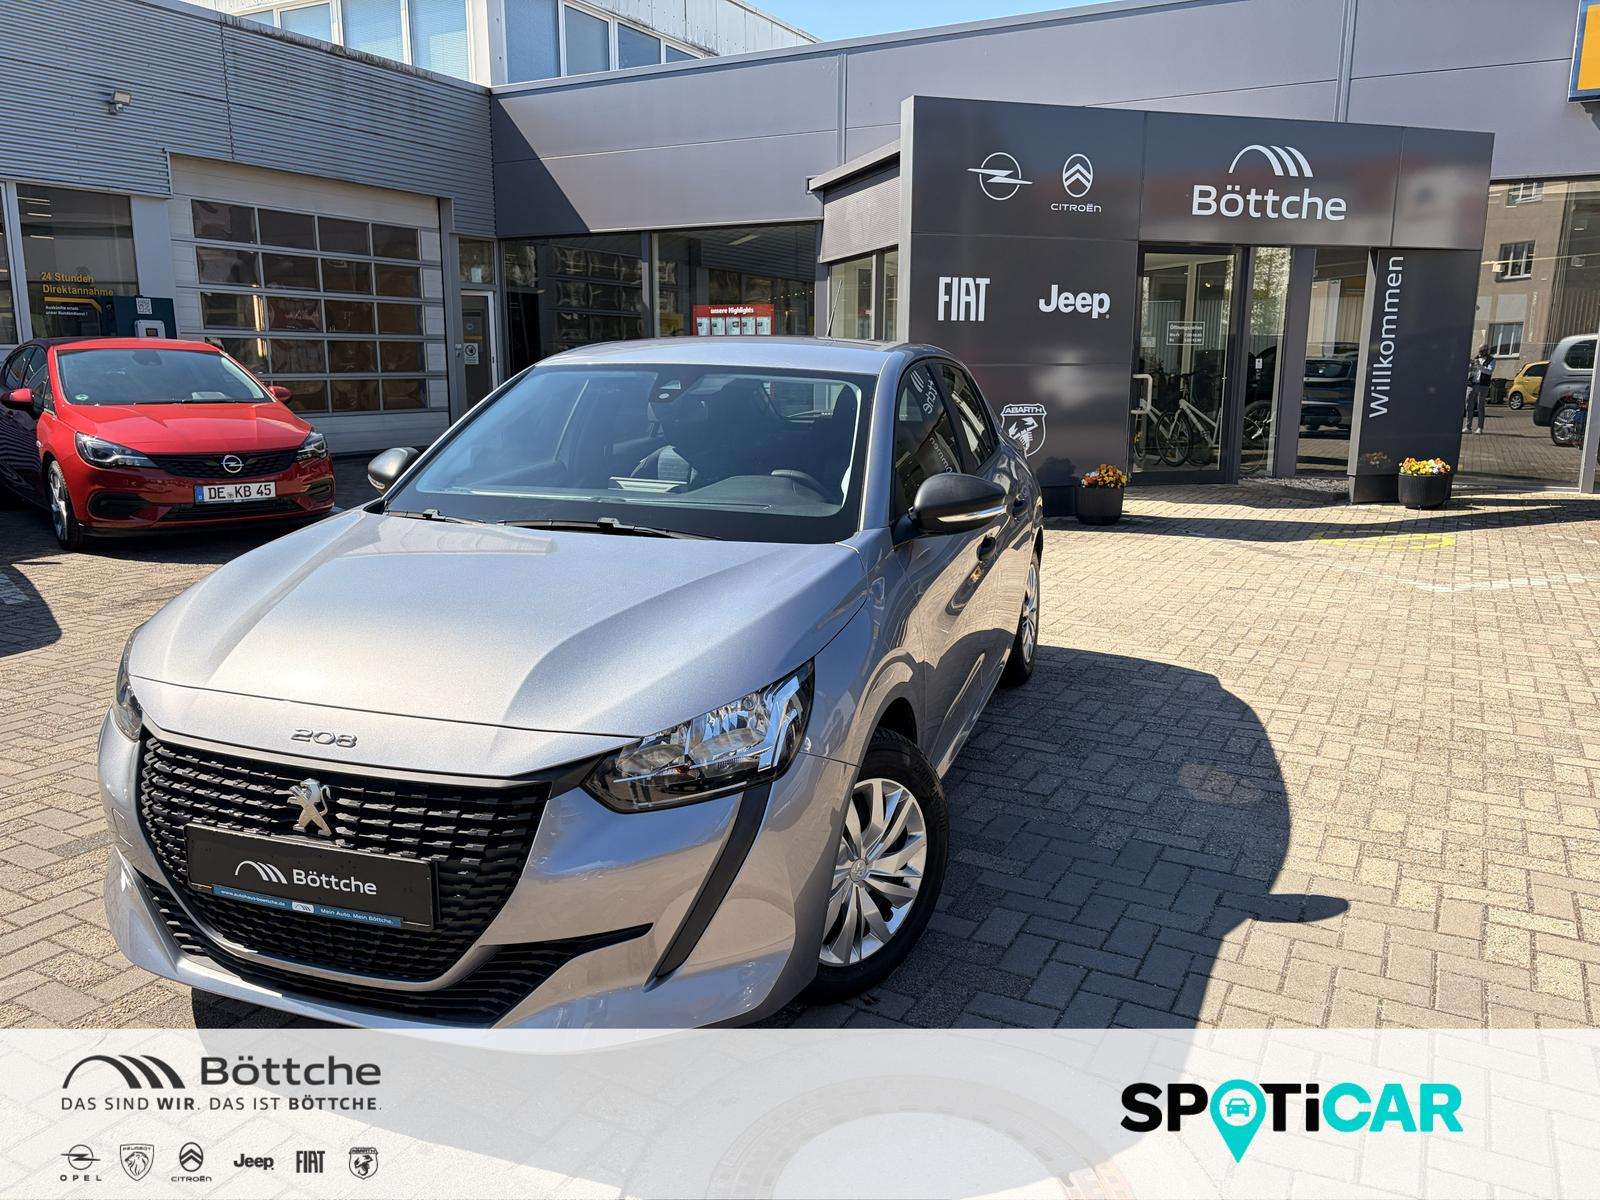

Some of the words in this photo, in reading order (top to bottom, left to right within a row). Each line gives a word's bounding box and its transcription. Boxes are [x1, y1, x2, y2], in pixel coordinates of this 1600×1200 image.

[1192, 184, 1347, 221] Böttche
[41, 271, 52, 280] 24
[54, 272, 94, 283] Stunden
[42, 283, 113, 297] Direktannahme
[937, 276, 991, 322] FIAT
[728, 306, 754, 315] Highlights
[1369, 256, 1404, 418] Willkommen
[1005, 406, 1043, 414] ABARTH
[208, 486, 226, 499] DE
[234, 485, 252, 498] KB
[256, 483, 272, 497] 45
[290, 728, 358, 749] 208
[292, 868, 377, 895] Böttche
[353, 913, 368, 921] Mein
